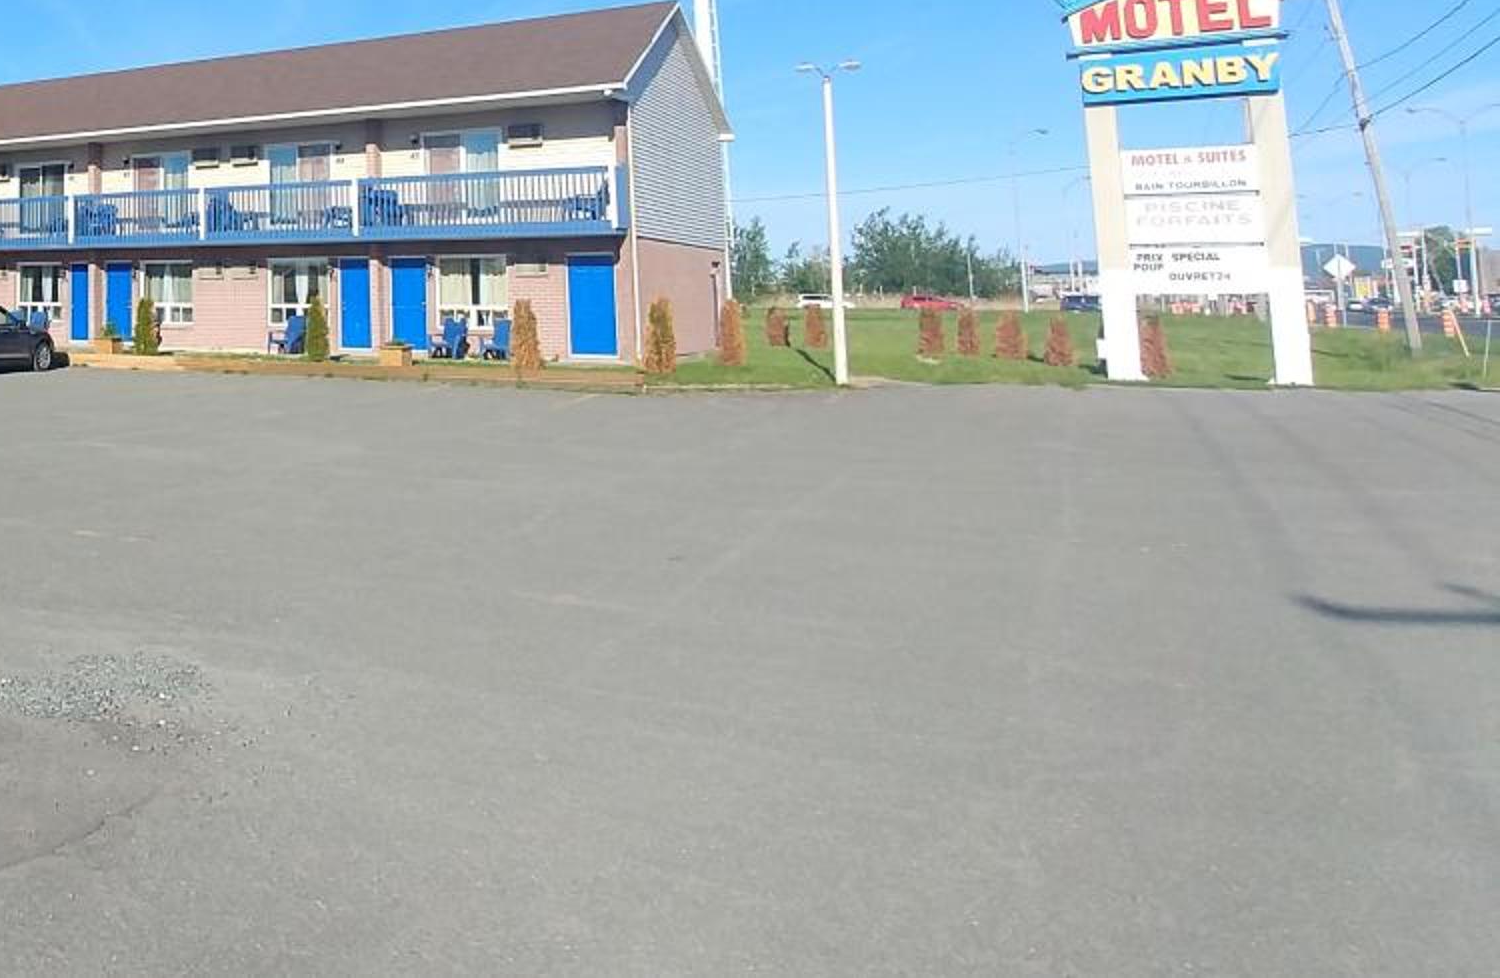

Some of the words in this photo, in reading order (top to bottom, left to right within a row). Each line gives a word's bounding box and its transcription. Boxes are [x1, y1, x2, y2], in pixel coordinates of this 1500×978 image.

[1082, 52, 1279, 94] GRANBY
[1131, 153, 1179, 166] MOTEL
[1198, 149, 1247, 163] SUITES
[1135, 182, 1164, 191] BAIN
[1169, 178, 1247, 190] TOURBILLON
[1145, 199, 1240, 213] PISCINE
[1137, 212, 1253, 227] FORFAITS
[1136, 253, 1163, 262] PRIX
[1171, 252, 1220, 262] SPECIAL
